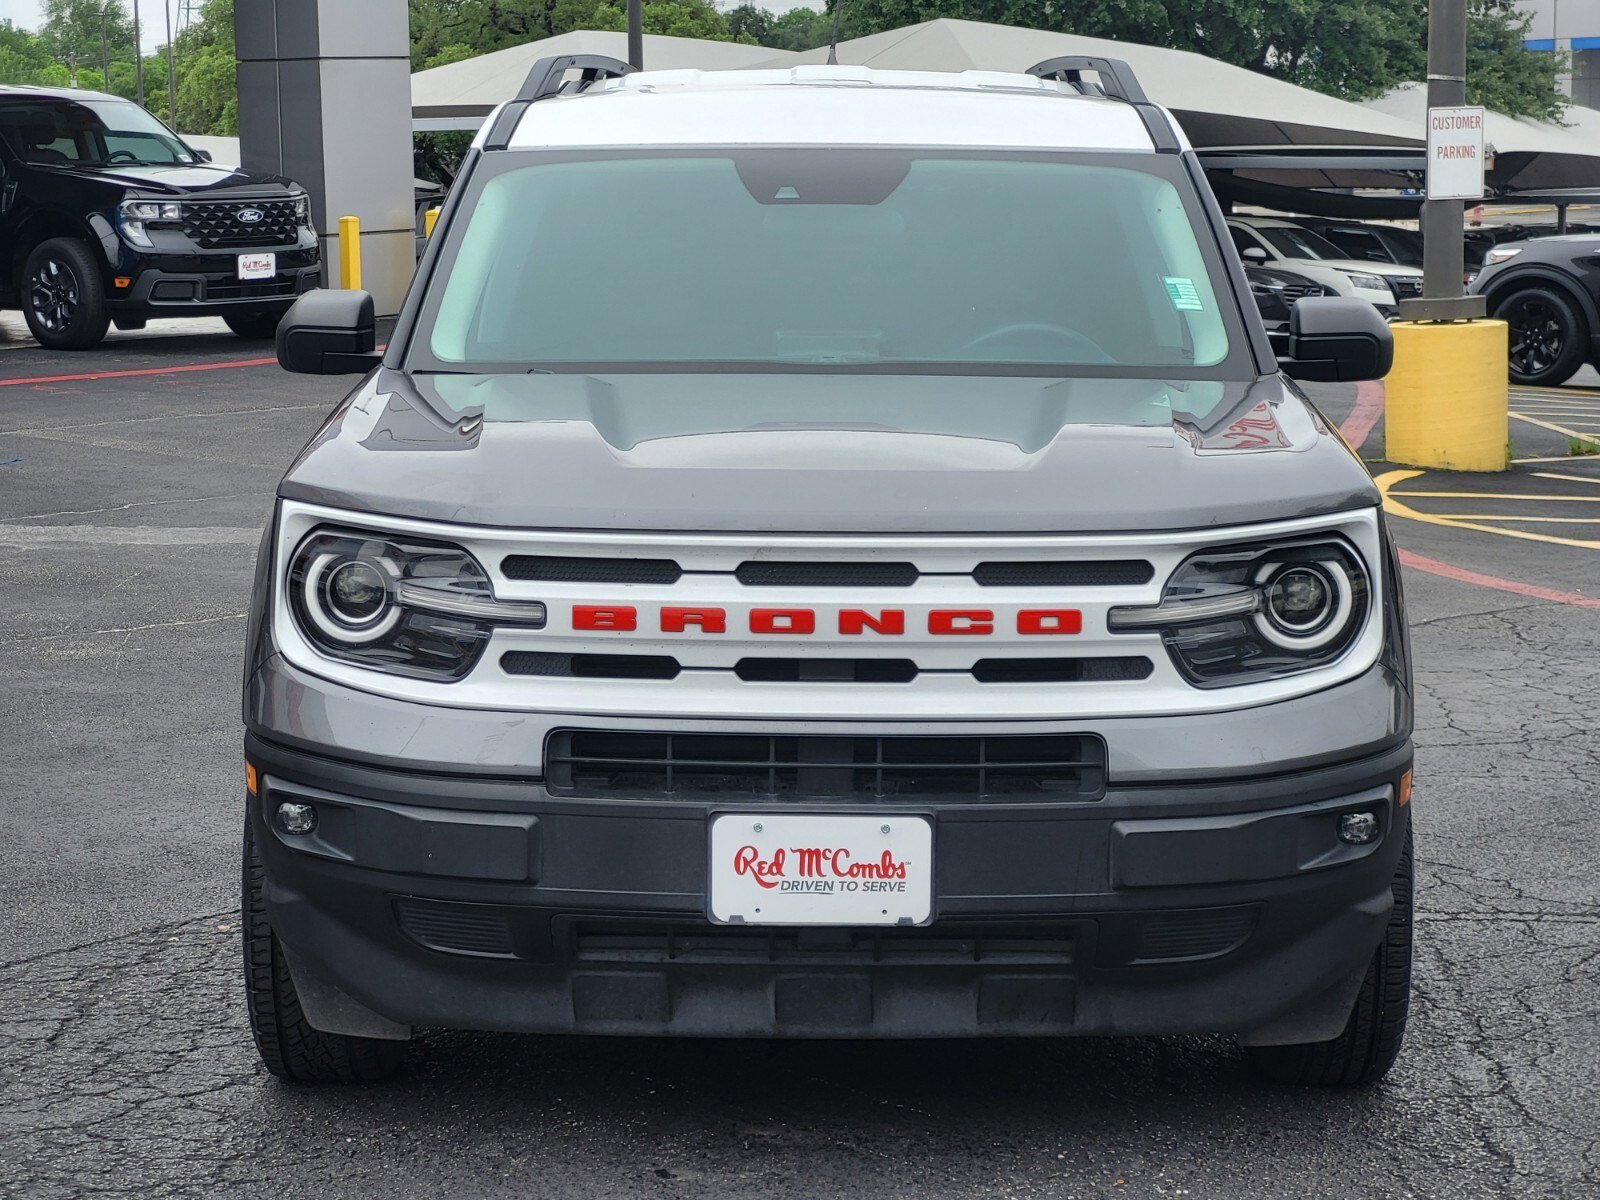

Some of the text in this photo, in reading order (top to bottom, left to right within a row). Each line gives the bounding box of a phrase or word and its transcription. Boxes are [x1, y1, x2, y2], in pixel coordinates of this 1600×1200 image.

[1432, 115, 1481, 131] CUSTOMER
[1437, 144, 1476, 159] PARKING
[242, 211, 259, 221] Ford
[572, 604, 1083, 635] BRONCO
[734, 845, 786, 889] Red
[790, 847, 907, 879] McCombs
[780, 880, 907, 892] DRIVEN TO SERVE
